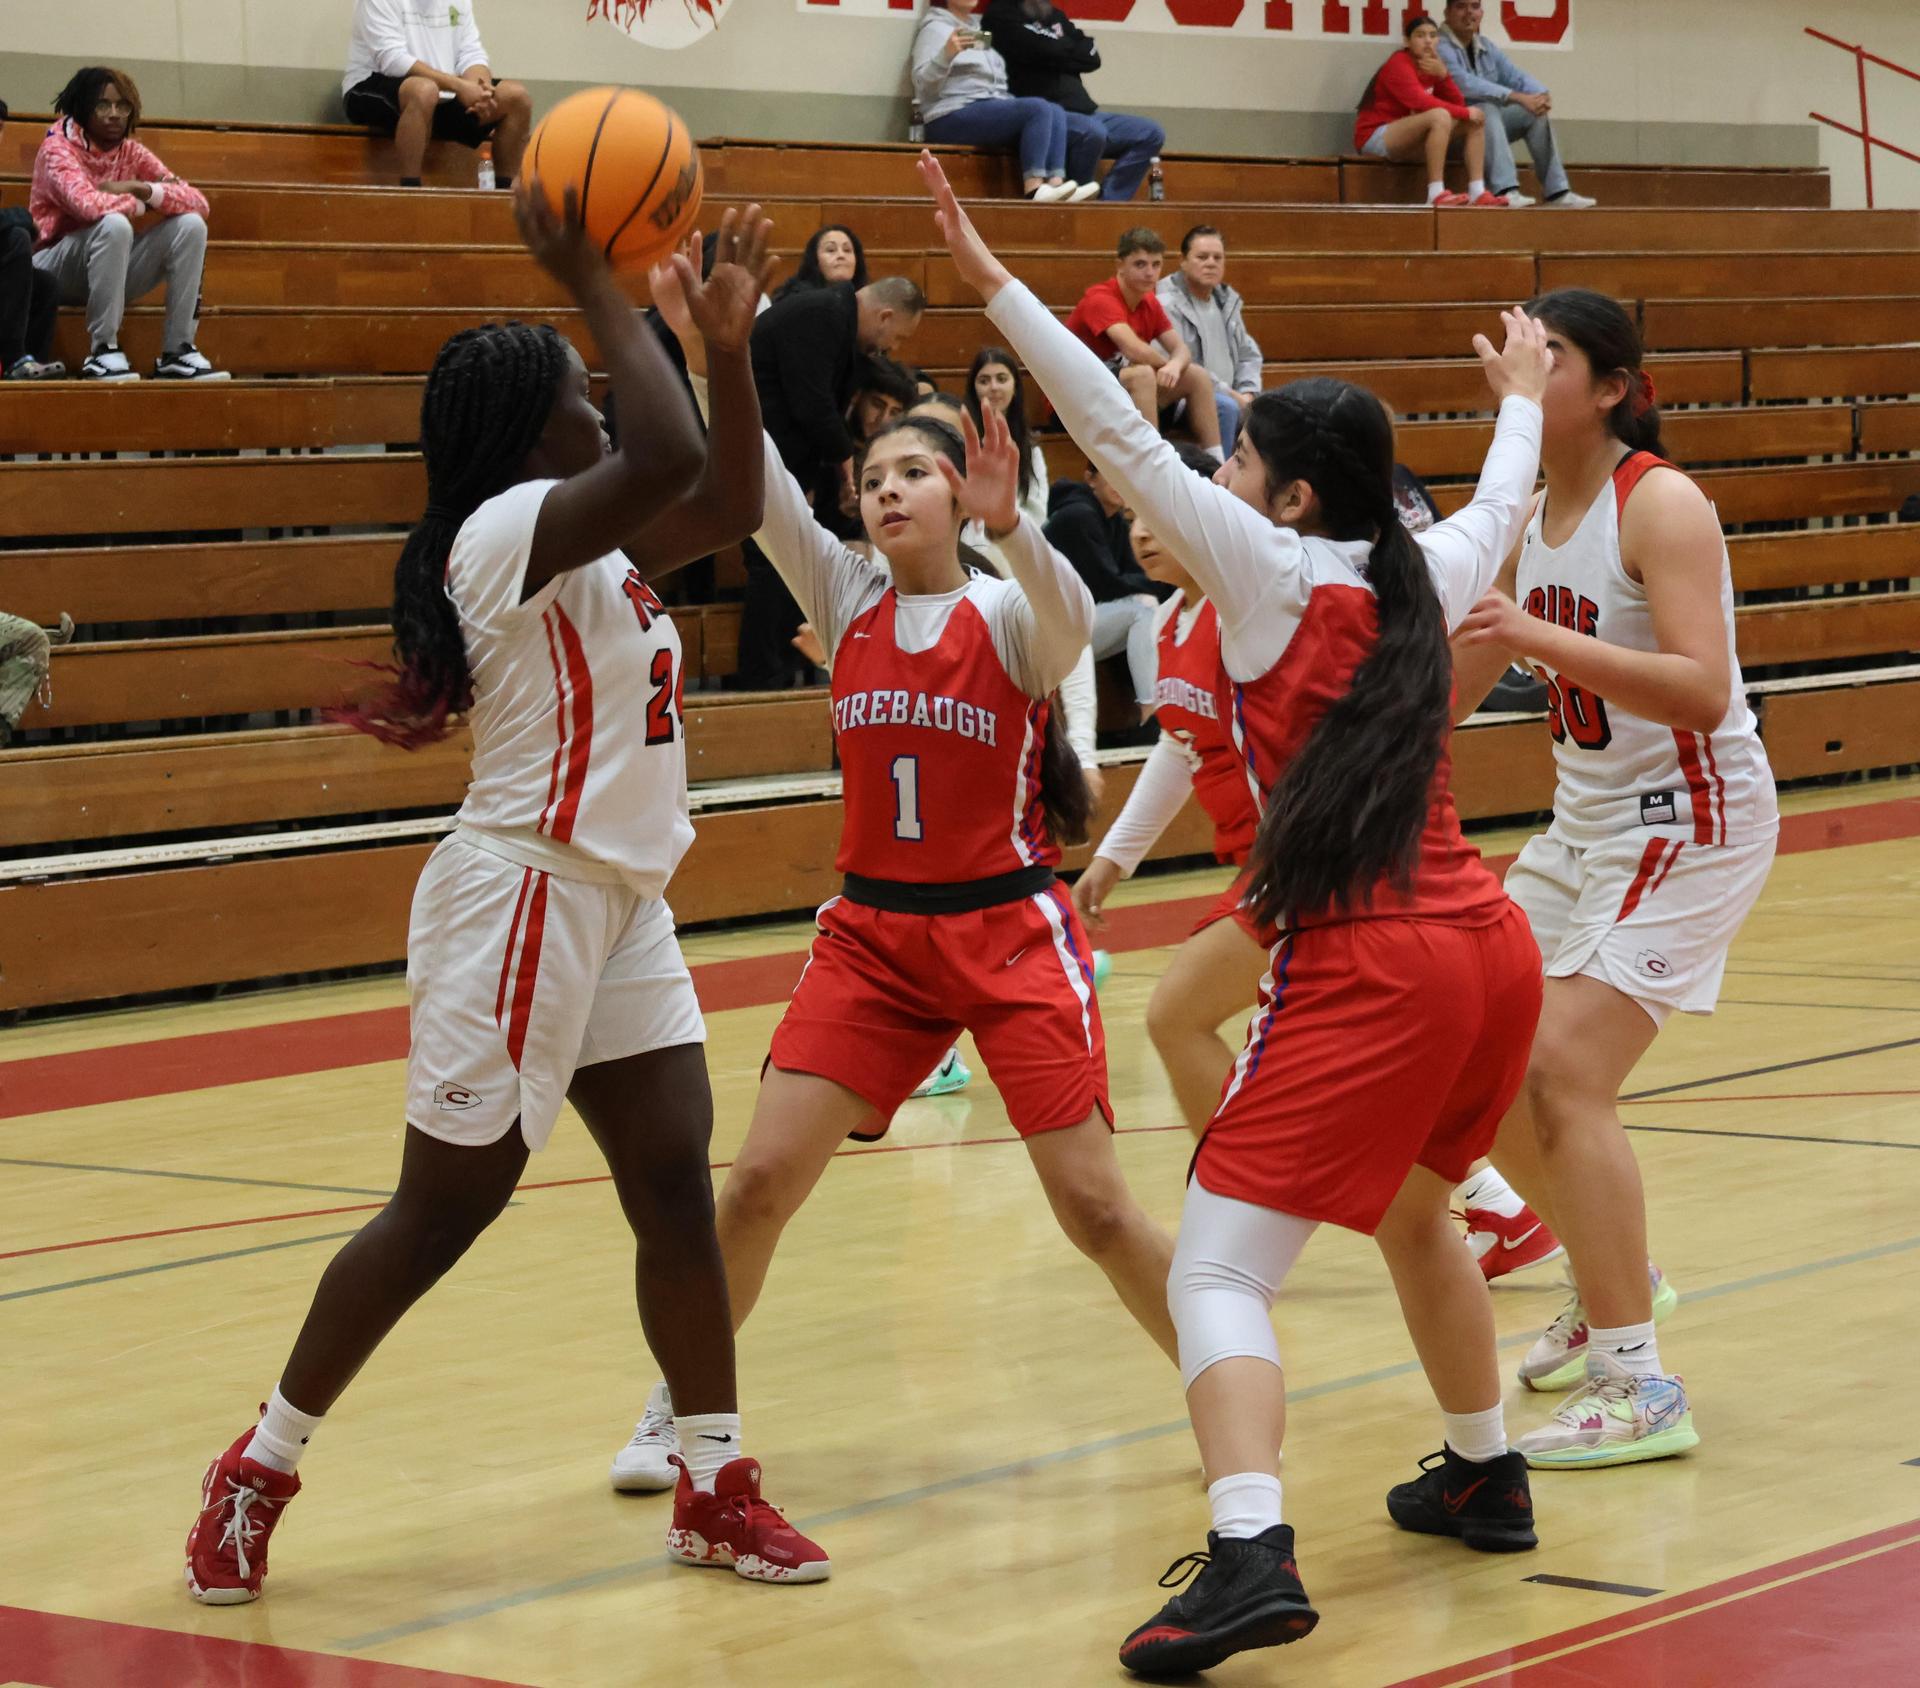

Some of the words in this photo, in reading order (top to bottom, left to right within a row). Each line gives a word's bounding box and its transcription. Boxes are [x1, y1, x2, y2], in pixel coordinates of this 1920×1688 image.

[1522, 585, 1599, 638] RIBE
[834, 689, 997, 748] FIREBAUGH
[889, 754, 924, 842] 1
[1650, 795, 1663, 805] M
[1647, 960, 1666, 974] C
[446, 1091, 470, 1105] C
